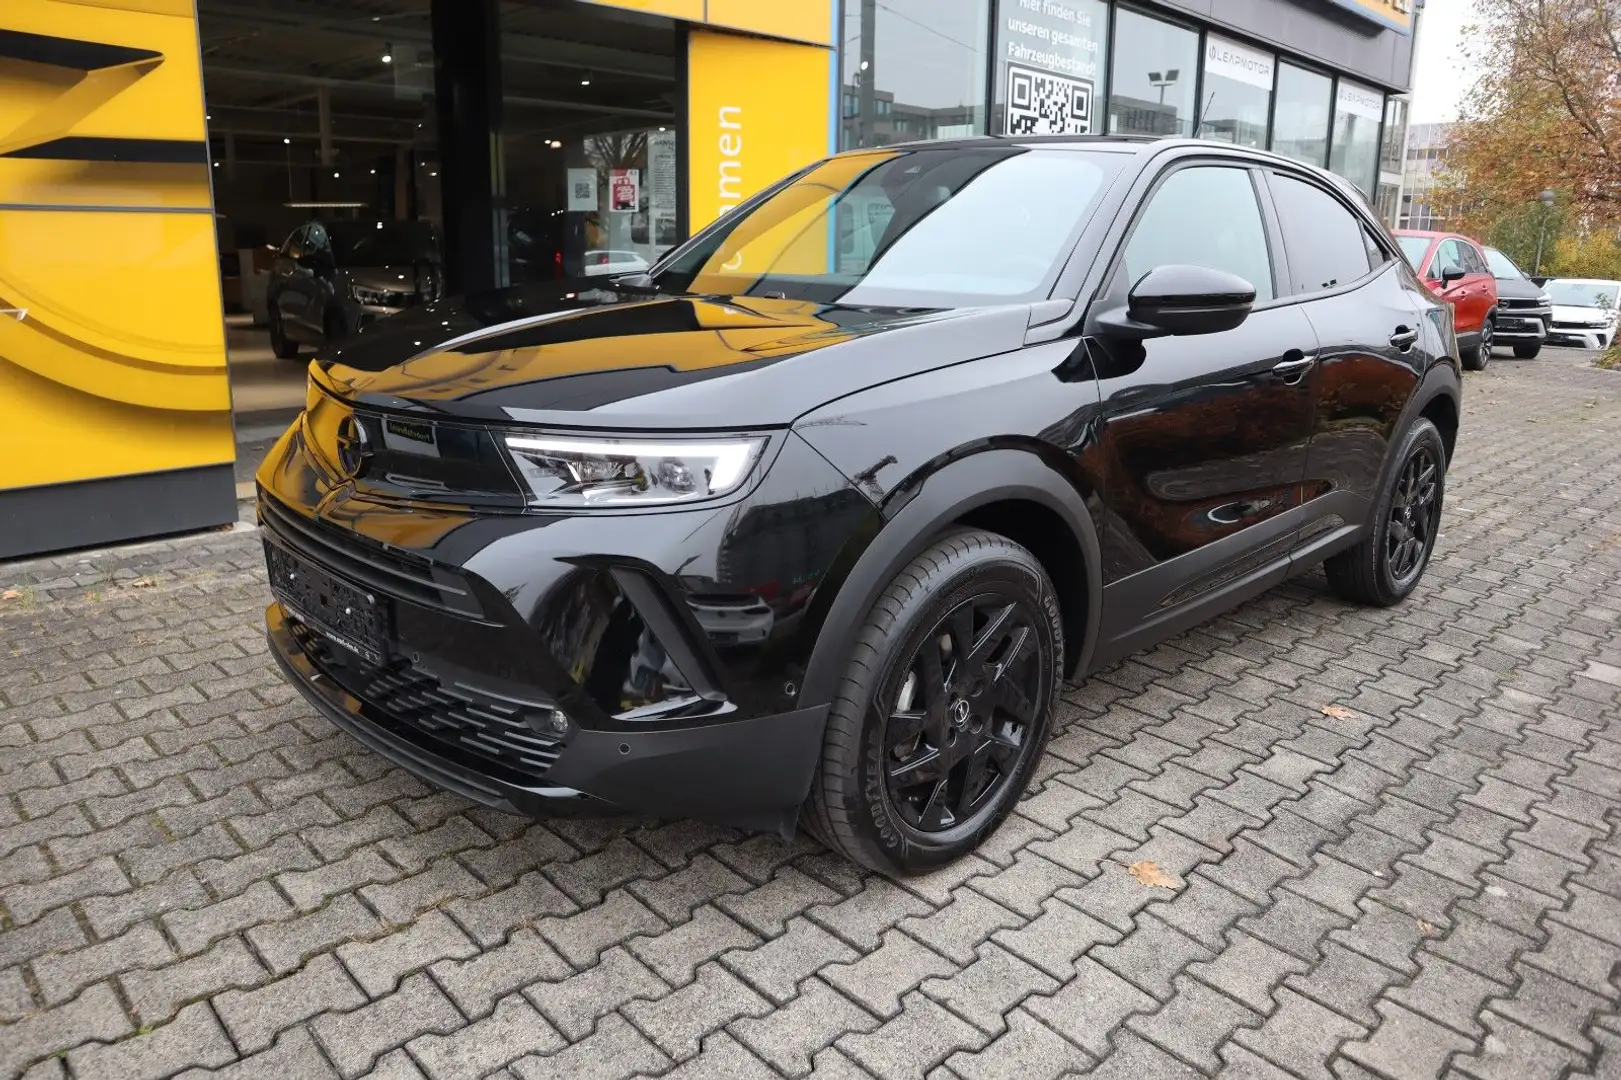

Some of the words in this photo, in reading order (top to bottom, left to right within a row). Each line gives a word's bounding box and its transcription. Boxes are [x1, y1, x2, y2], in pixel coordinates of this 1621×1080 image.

[1042, 0, 1075, 22] finden
[1077, 10, 1091, 27] Sie
[1008, 18, 1049, 40] unseren
[1051, 31, 1098, 54] gesamten
[1008, 41, 1096, 76] Fahrzeugbestand!
[1217, 49, 1270, 76] LEAPMOTOR
[1344, 91, 1380, 110] LEAPMOTOR
